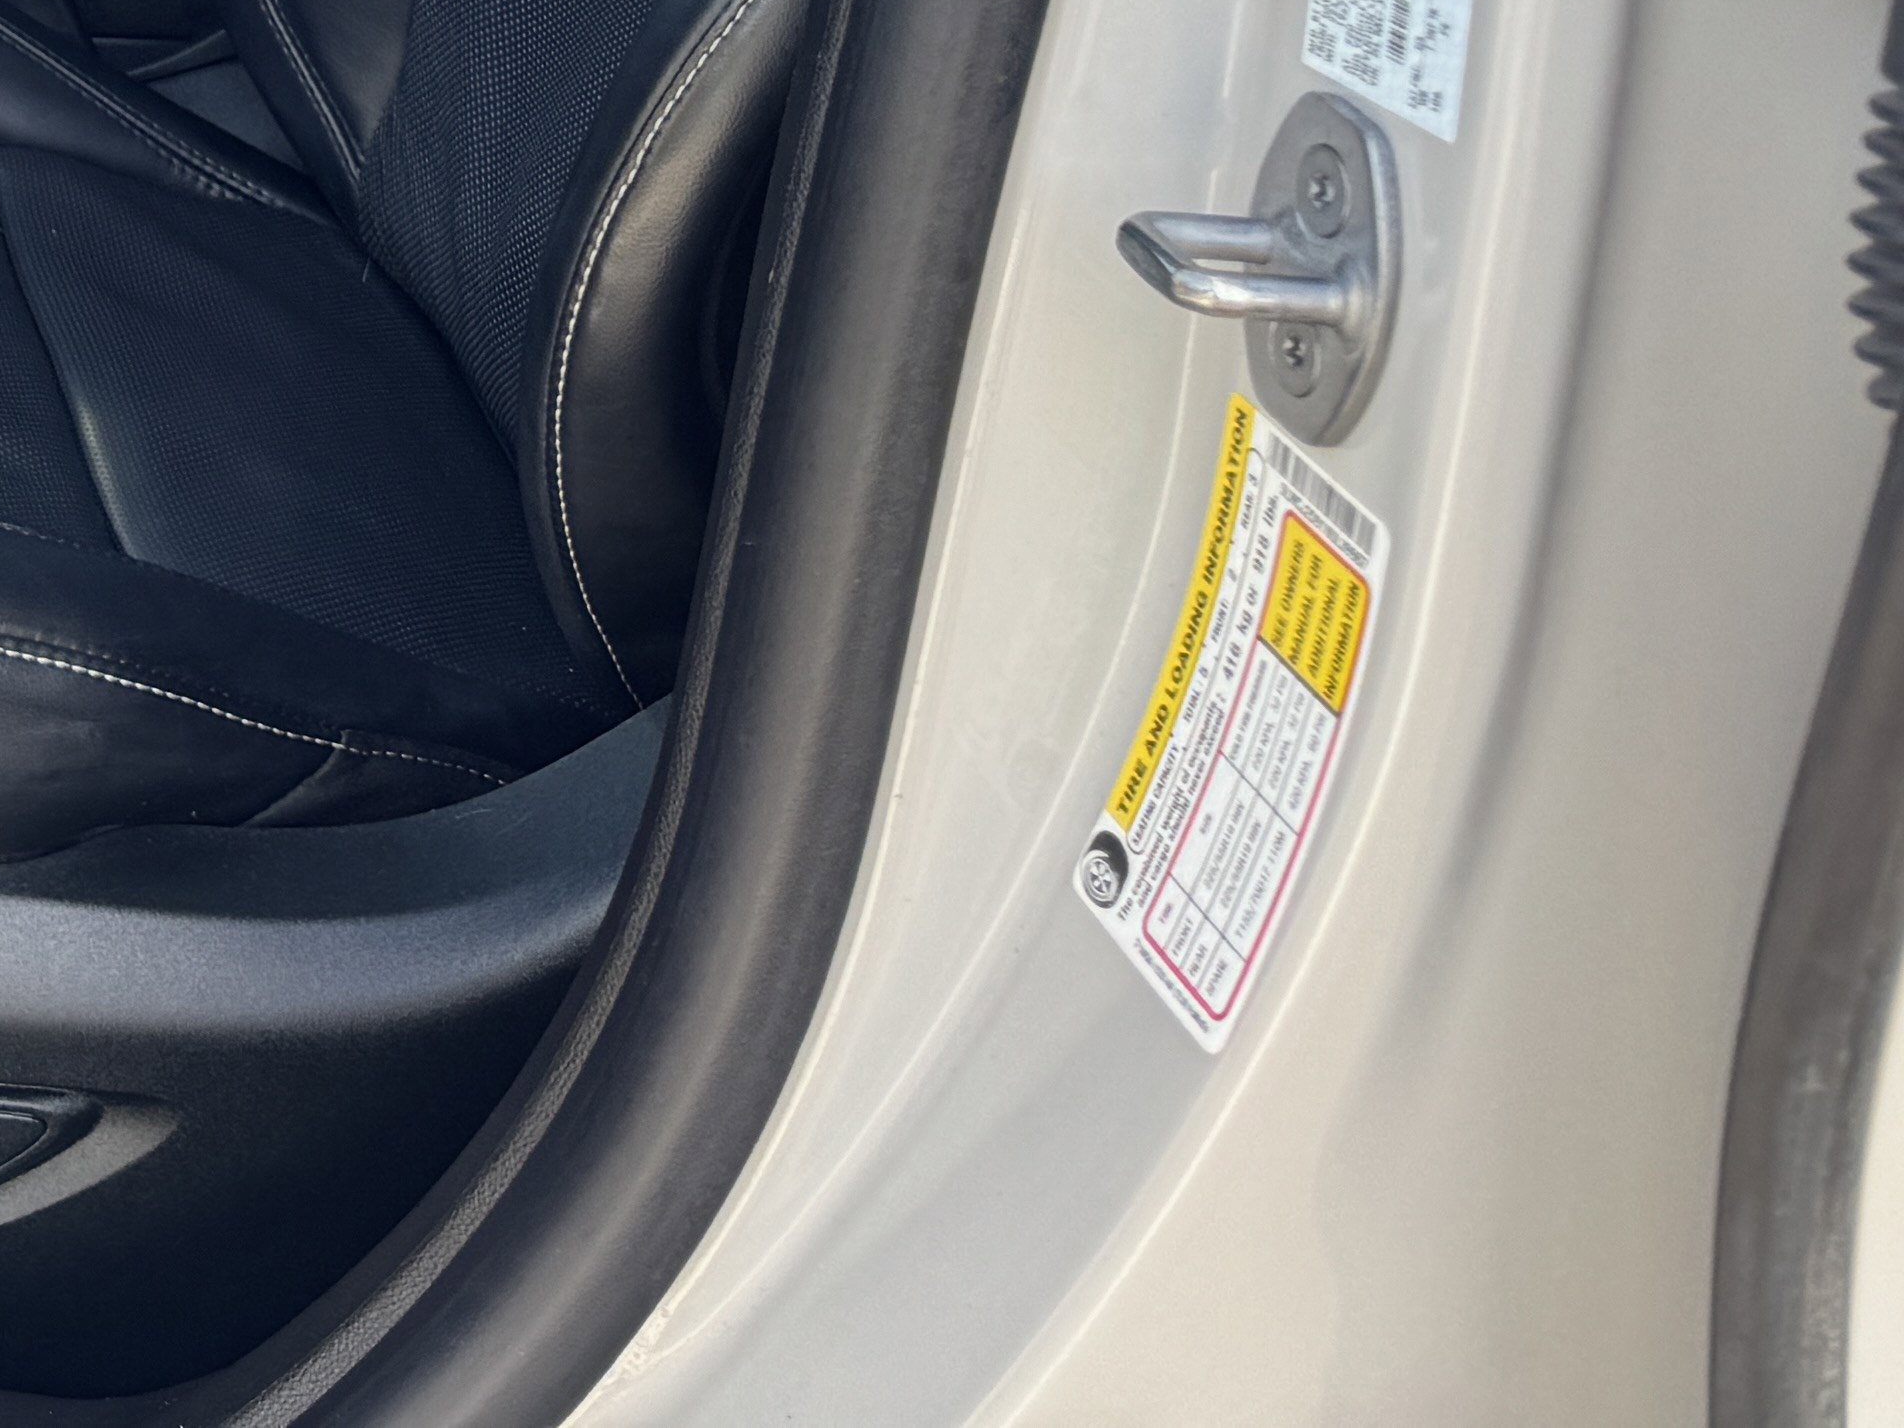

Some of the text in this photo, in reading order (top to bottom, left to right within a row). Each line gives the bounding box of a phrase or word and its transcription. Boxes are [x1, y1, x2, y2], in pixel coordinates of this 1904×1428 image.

[1115, 407, 1248, 814] TIRE AND LOADING INFORMATION
[1234, 609, 1254, 636] kg
[1246, 583, 1257, 607] or
[1268, 612, 1287, 647] SEE
[1286, 553, 1323, 665] MANUAL FOR
[1306, 576, 1339, 679] ADDITIONAL
[1320, 579, 1360, 700] INFORMATION
